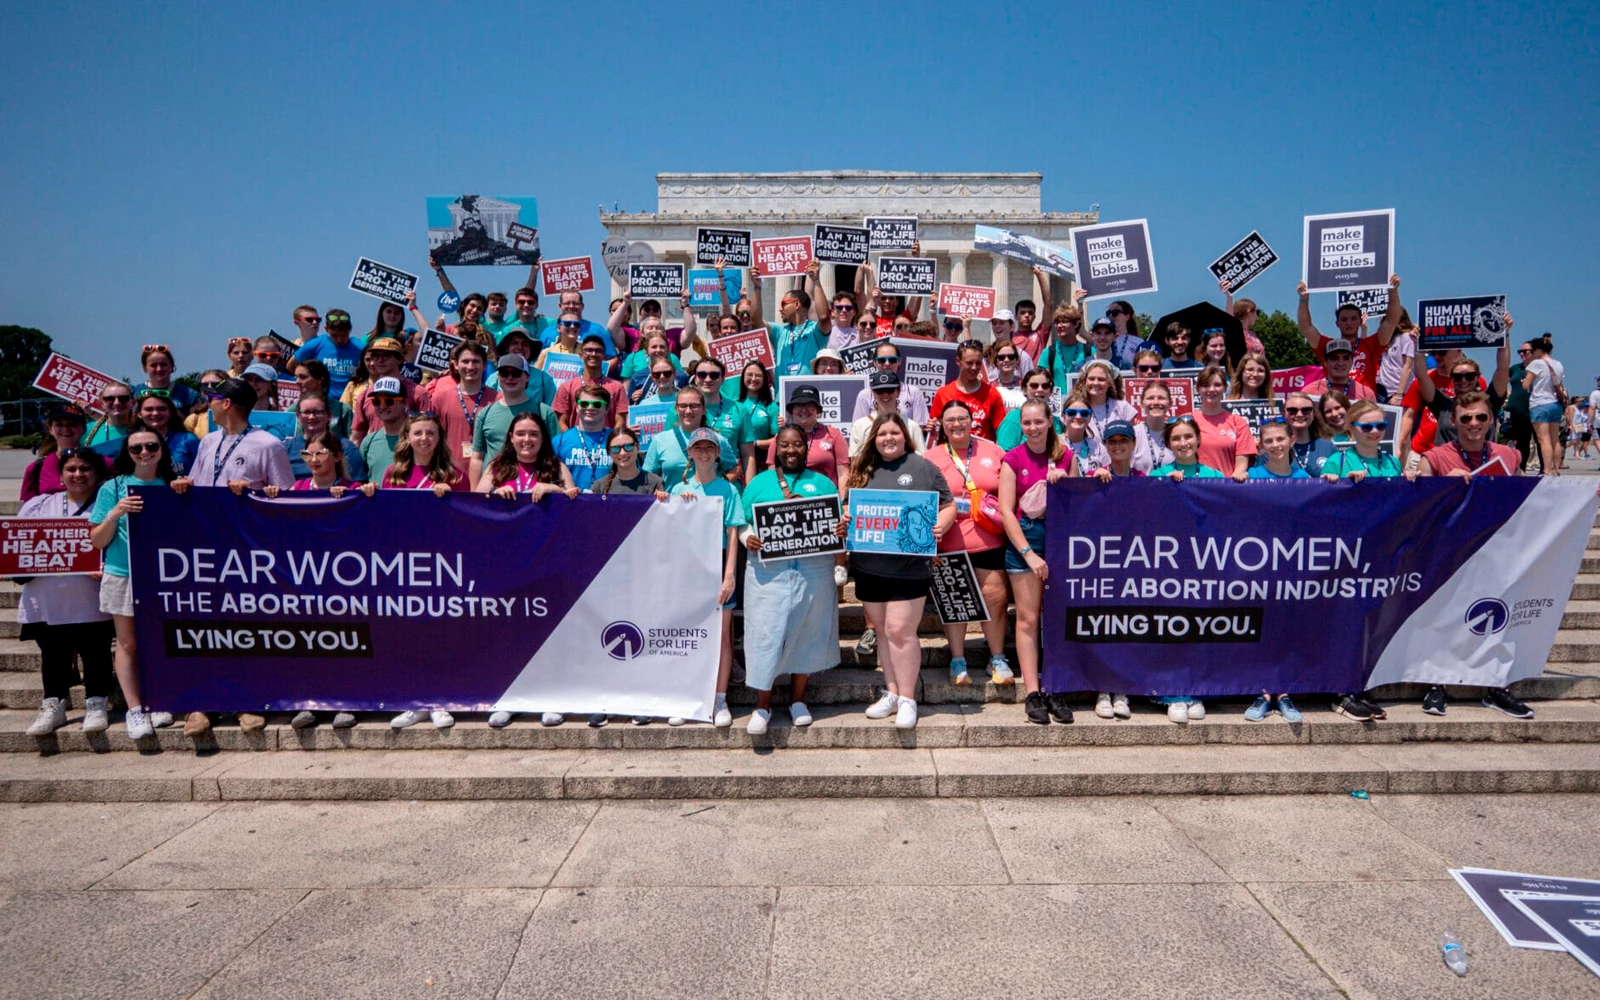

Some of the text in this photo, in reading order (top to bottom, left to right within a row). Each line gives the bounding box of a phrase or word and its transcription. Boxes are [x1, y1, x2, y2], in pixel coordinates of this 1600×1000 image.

[846, 233, 866, 242] THE
[1323, 229, 1361, 241] make
[602, 242, 626, 255] Love
[699, 243, 749, 254] PRO-LIFE
[760, 244, 804, 254] LET THEIR
[816, 240, 868, 252] PRO-LIFE
[1089, 238, 1122, 250] make
[1323, 241, 1360, 252] more
[758, 251, 808, 263] HEARTS
[816, 250, 866, 260] GENERATION
[1090, 250, 1123, 262] more
[1224, 256, 1240, 270] AM
[1240, 240, 1260, 256] THE
[767, 261, 799, 272] BEAT
[1220, 244, 1269, 282] PRO-LIFE
[1322, 255, 1373, 269] babies.
[548, 264, 586, 274] LET THEIR
[1092, 263, 1138, 277] babies.
[369, 267, 387, 279] AM
[391, 275, 411, 287] THE
[546, 270, 589, 283] HEARTS
[632, 278, 681, 286] PRO-LIFE
[880, 272, 933, 282] PRO-LIFE
[356, 271, 412, 295] PRO-LIFE
[555, 280, 582, 291] BEAT
[881, 282, 932, 290] GENERATION
[632, 286, 680, 294] GENERATION
[965, 292, 989, 300] THEIR
[1349, 292, 1365, 300] AM
[1368, 288, 1388, 296] THE
[944, 297, 990, 307] HEARTS
[951, 305, 982, 315] BEAT
[1425, 304, 1471, 317] HUMAN
[1424, 315, 1471, 327] RIGHTS
[1424, 325, 1472, 336] FOR ALL
[716, 338, 761, 355] LET THEIR
[716, 345, 766, 363] HEARTS
[853, 351, 868, 360] AM
[57, 363, 80, 377] LET
[907, 360, 945, 374] make
[49, 368, 103, 397] HEART
[906, 376, 942, 387] more
[1289, 375, 1305, 388] IS
[56, 382, 99, 404] BEAT
[821, 393, 838, 405] ke
[1255, 406, 1281, 415] THE
[635, 414, 666, 424] PROTEC
[761, 507, 833, 526] I AM THE
[856, 505, 903, 517] PROTECT
[759, 518, 839, 541] PRO-LIFE
[856, 516, 900, 531] EVERY
[8, 529, 89, 539] LET THEIR
[855, 530, 885, 543] LIFE!
[3, 540, 93, 554] HEARTS
[763, 534, 839, 553] GENERATION
[18, 553, 78, 568] BEAT
[1068, 536, 1371, 573] DEAR WOMEN,
[158, 548, 475, 592] DEAR WOMEN,
[940, 557, 969, 621] PRO-LIFE
[1066, 572, 1422, 600] THE ABORTION INDUSTRY IS
[932, 566, 956, 620] ENERATION
[953, 568, 967, 588] AM
[963, 593, 978, 617] THE
[157, 592, 548, 617] THE ABORTION INDUSTRY IS
[1512, 599, 1554, 612] STUDENTS
[1523, 609, 1542, 618] LIFE
[1076, 614, 1256, 636] LYING TO YOU.
[649, 628, 708, 638] STUDENTS
[176, 629, 367, 651] LYING TO YOU.
[649, 639, 698, 650] FOR LIFE
